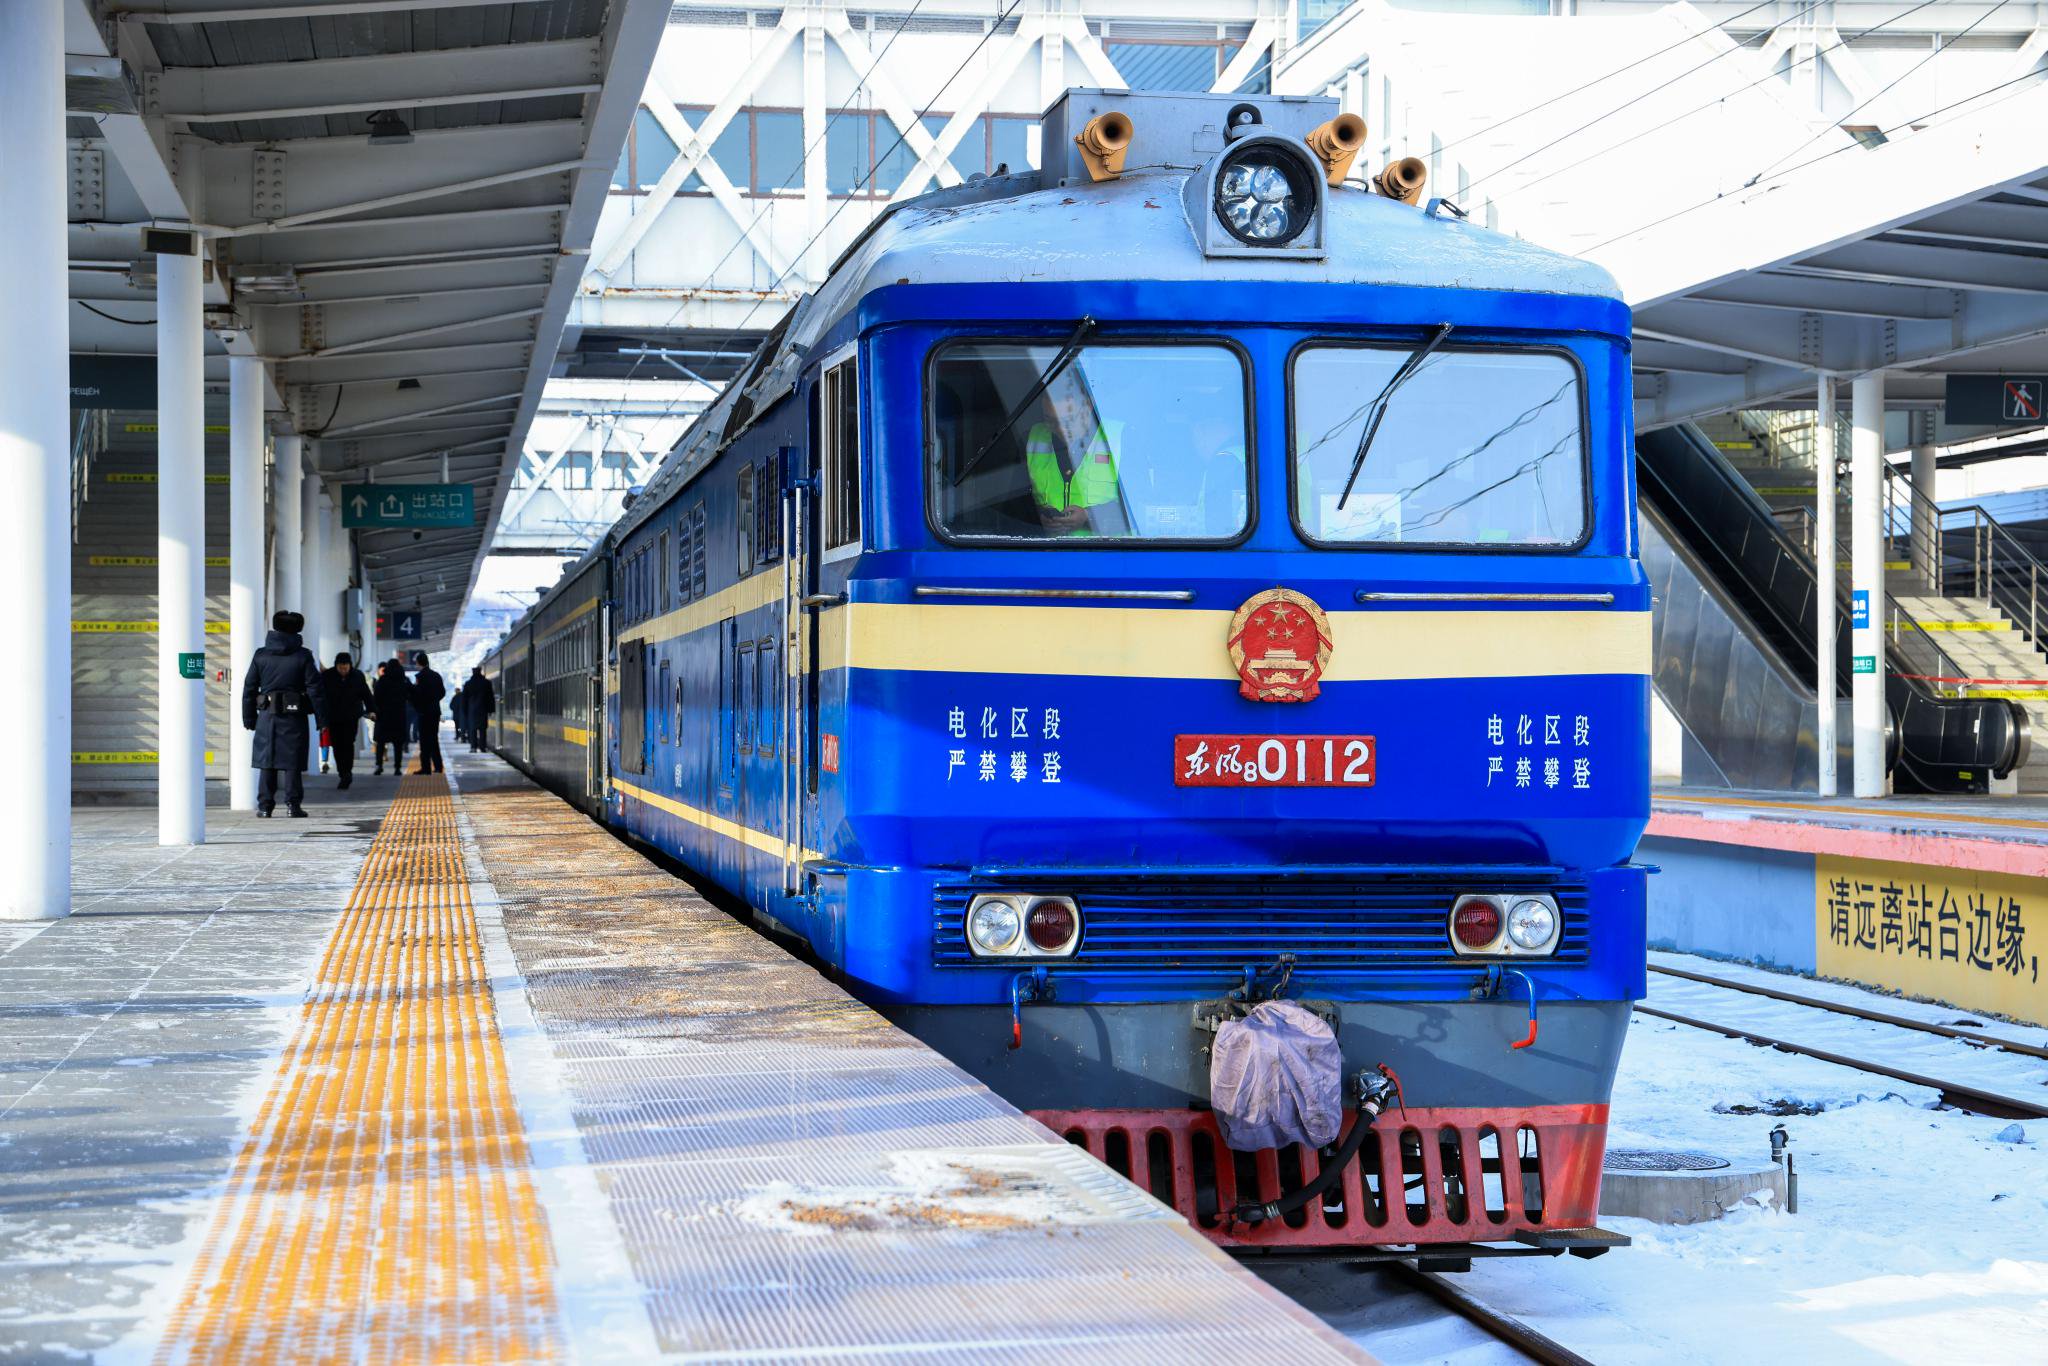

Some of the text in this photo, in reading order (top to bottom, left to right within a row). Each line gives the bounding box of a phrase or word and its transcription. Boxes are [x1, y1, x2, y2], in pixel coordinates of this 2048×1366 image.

[412, 493, 463, 508] 出站口
[400, 616, 414, 635] 4
[948, 705, 1061, 739] 电化区段
[1487, 713, 1590, 746] 电化区段
[947, 748, 1062, 783] 严禁攀登
[1486, 755, 1591, 789] 严禁攀登
